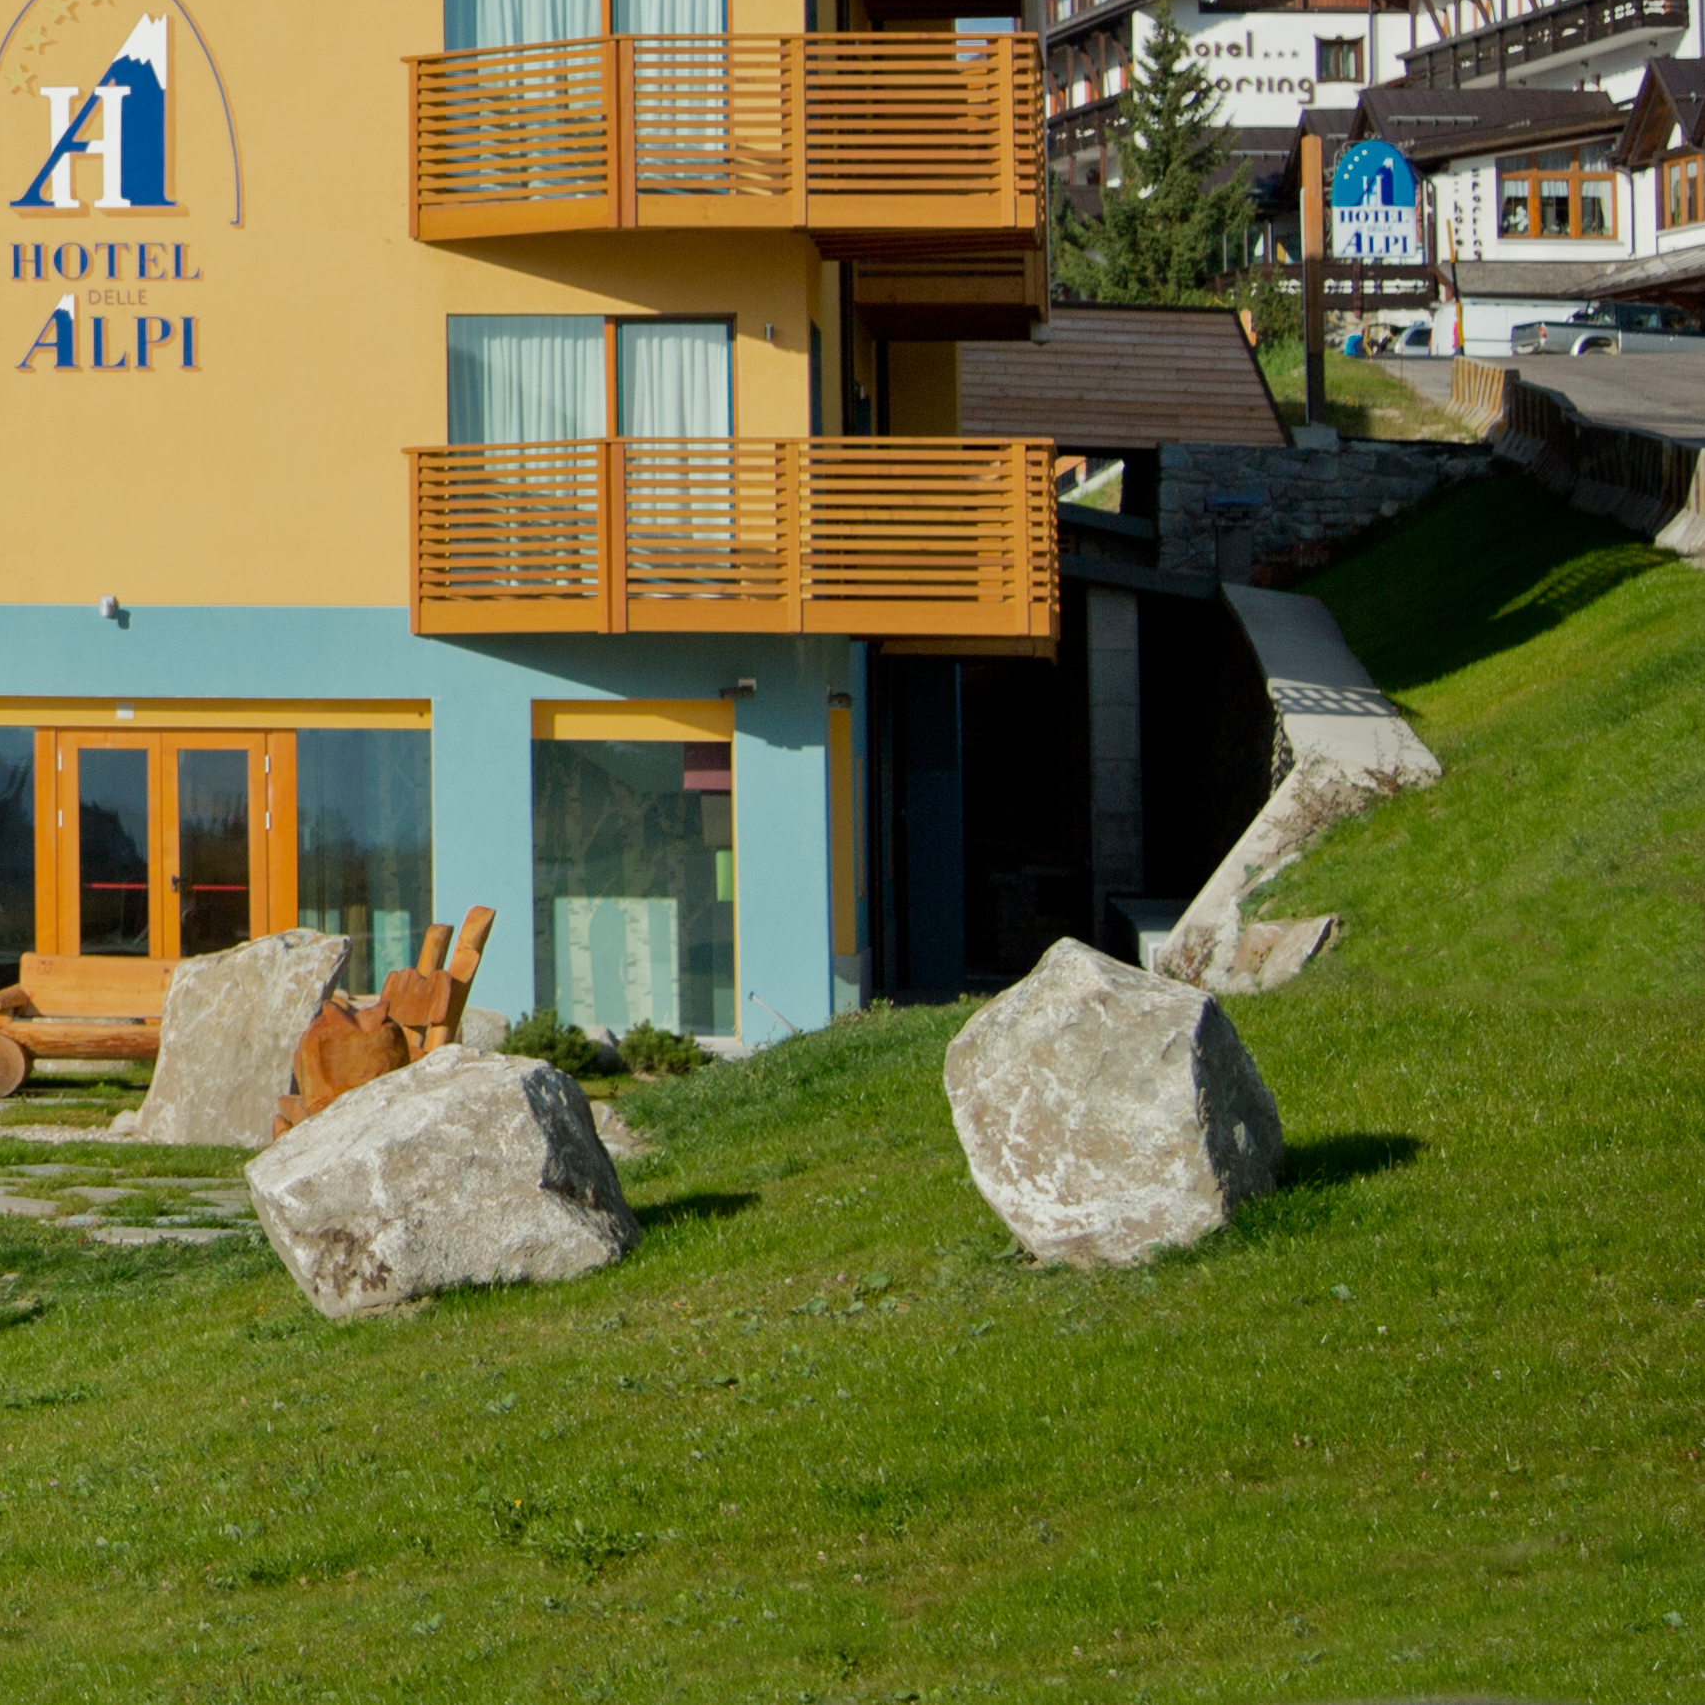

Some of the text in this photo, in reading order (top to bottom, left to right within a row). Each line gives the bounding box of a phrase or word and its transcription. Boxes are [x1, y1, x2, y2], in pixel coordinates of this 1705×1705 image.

[1183, 30, 1253, 58] otel
[1340, 210, 1410, 223] HOTEL
[1342, 227, 1408, 254] ALPI
[10, 242, 202, 281] HOTEL
[87, 288, 148, 305] DELLE
[15, 292, 199, 370] ALPI
